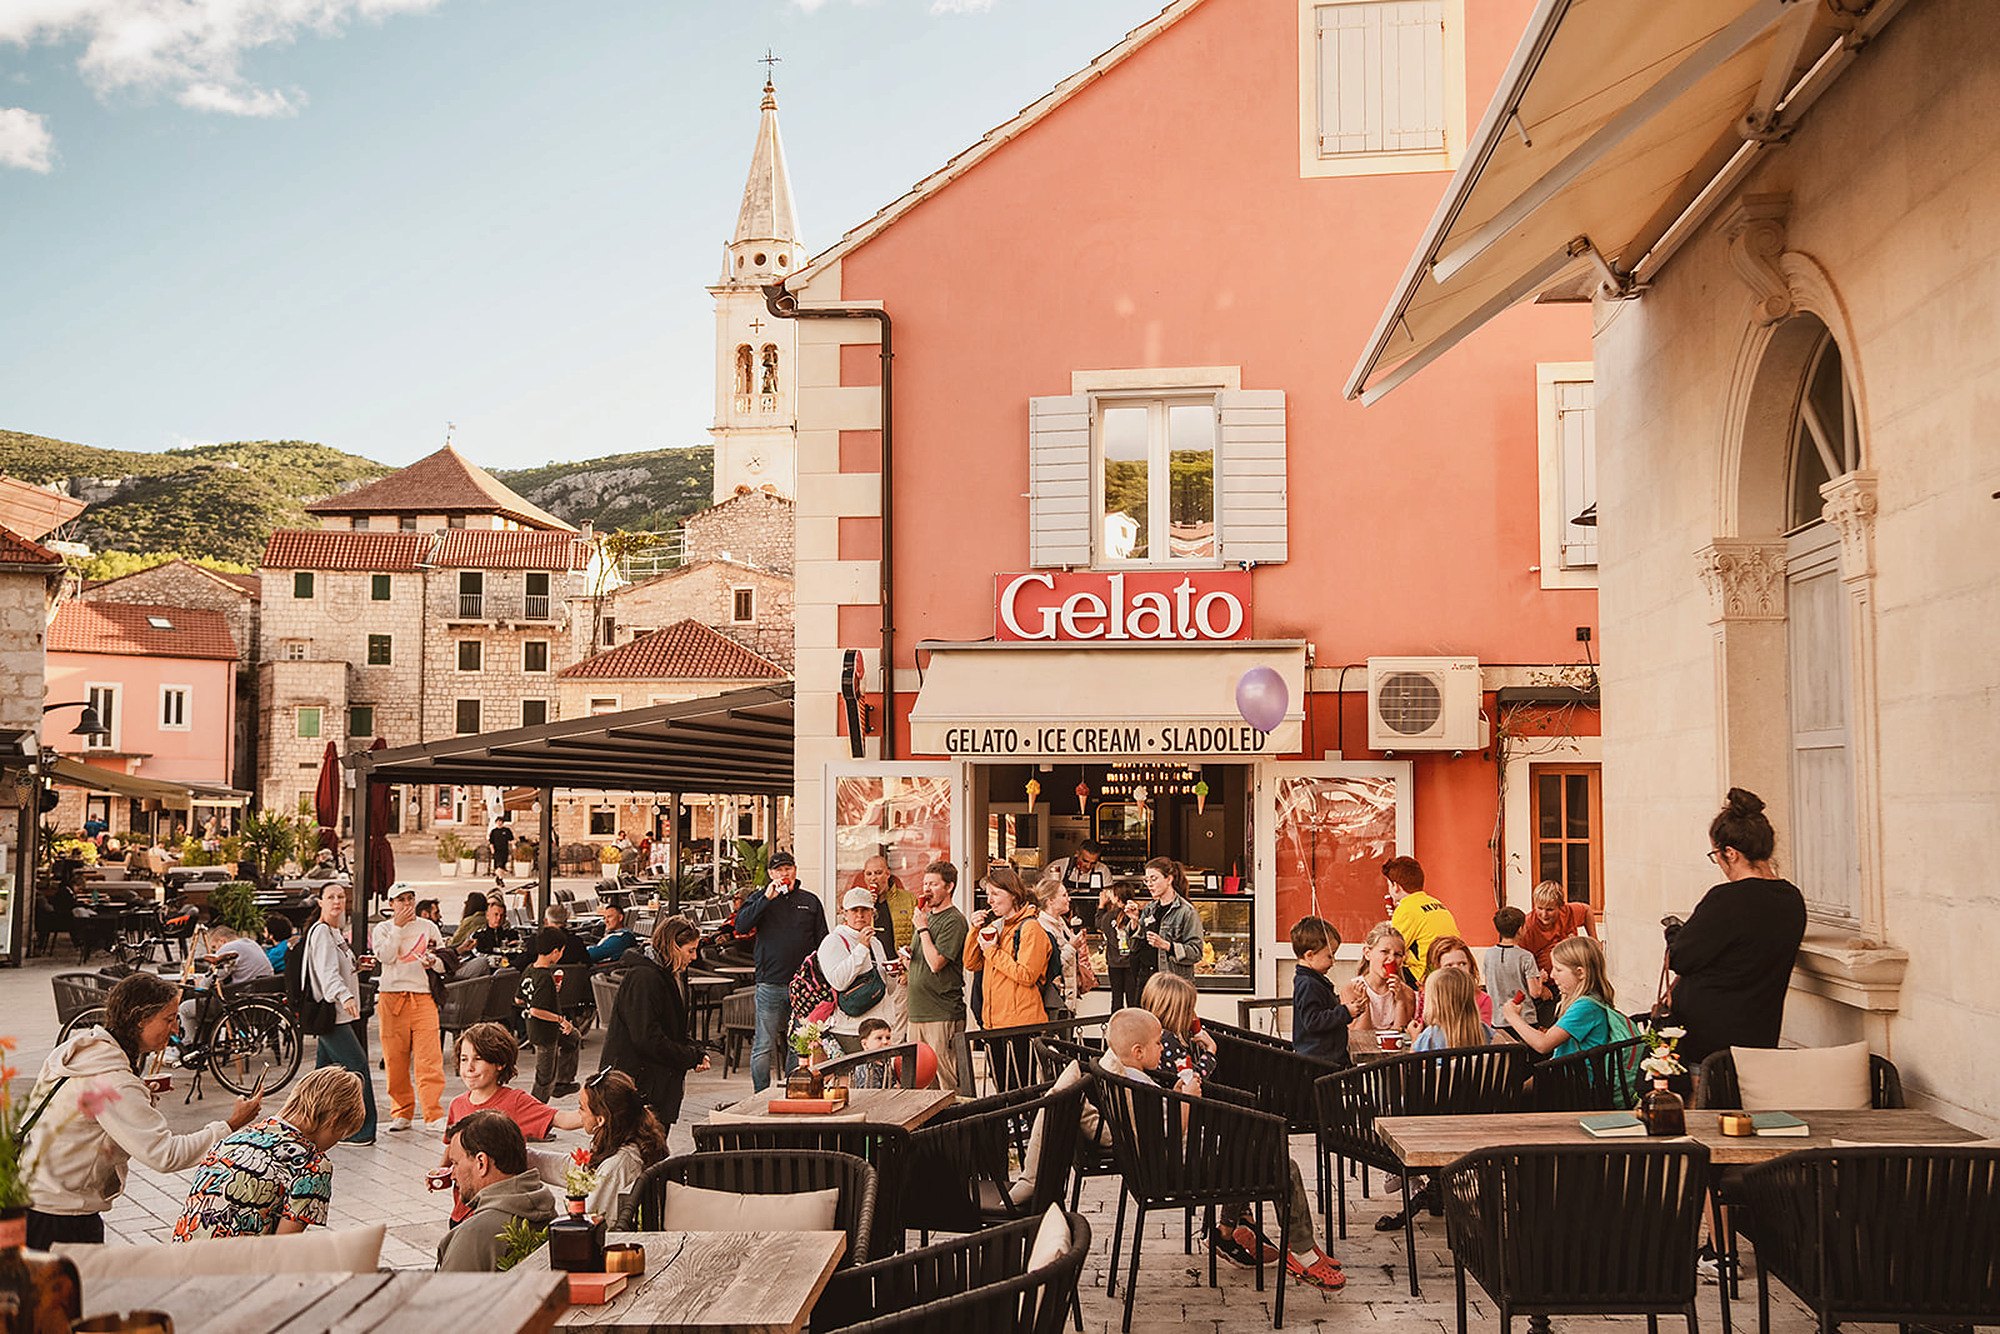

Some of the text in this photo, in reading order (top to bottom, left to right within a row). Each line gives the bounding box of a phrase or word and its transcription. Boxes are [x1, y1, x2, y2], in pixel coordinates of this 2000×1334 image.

[1000, 573, 1244, 639] Gelato
[946, 727, 1266, 753] GELATO ICE CREAM SLADOLED
